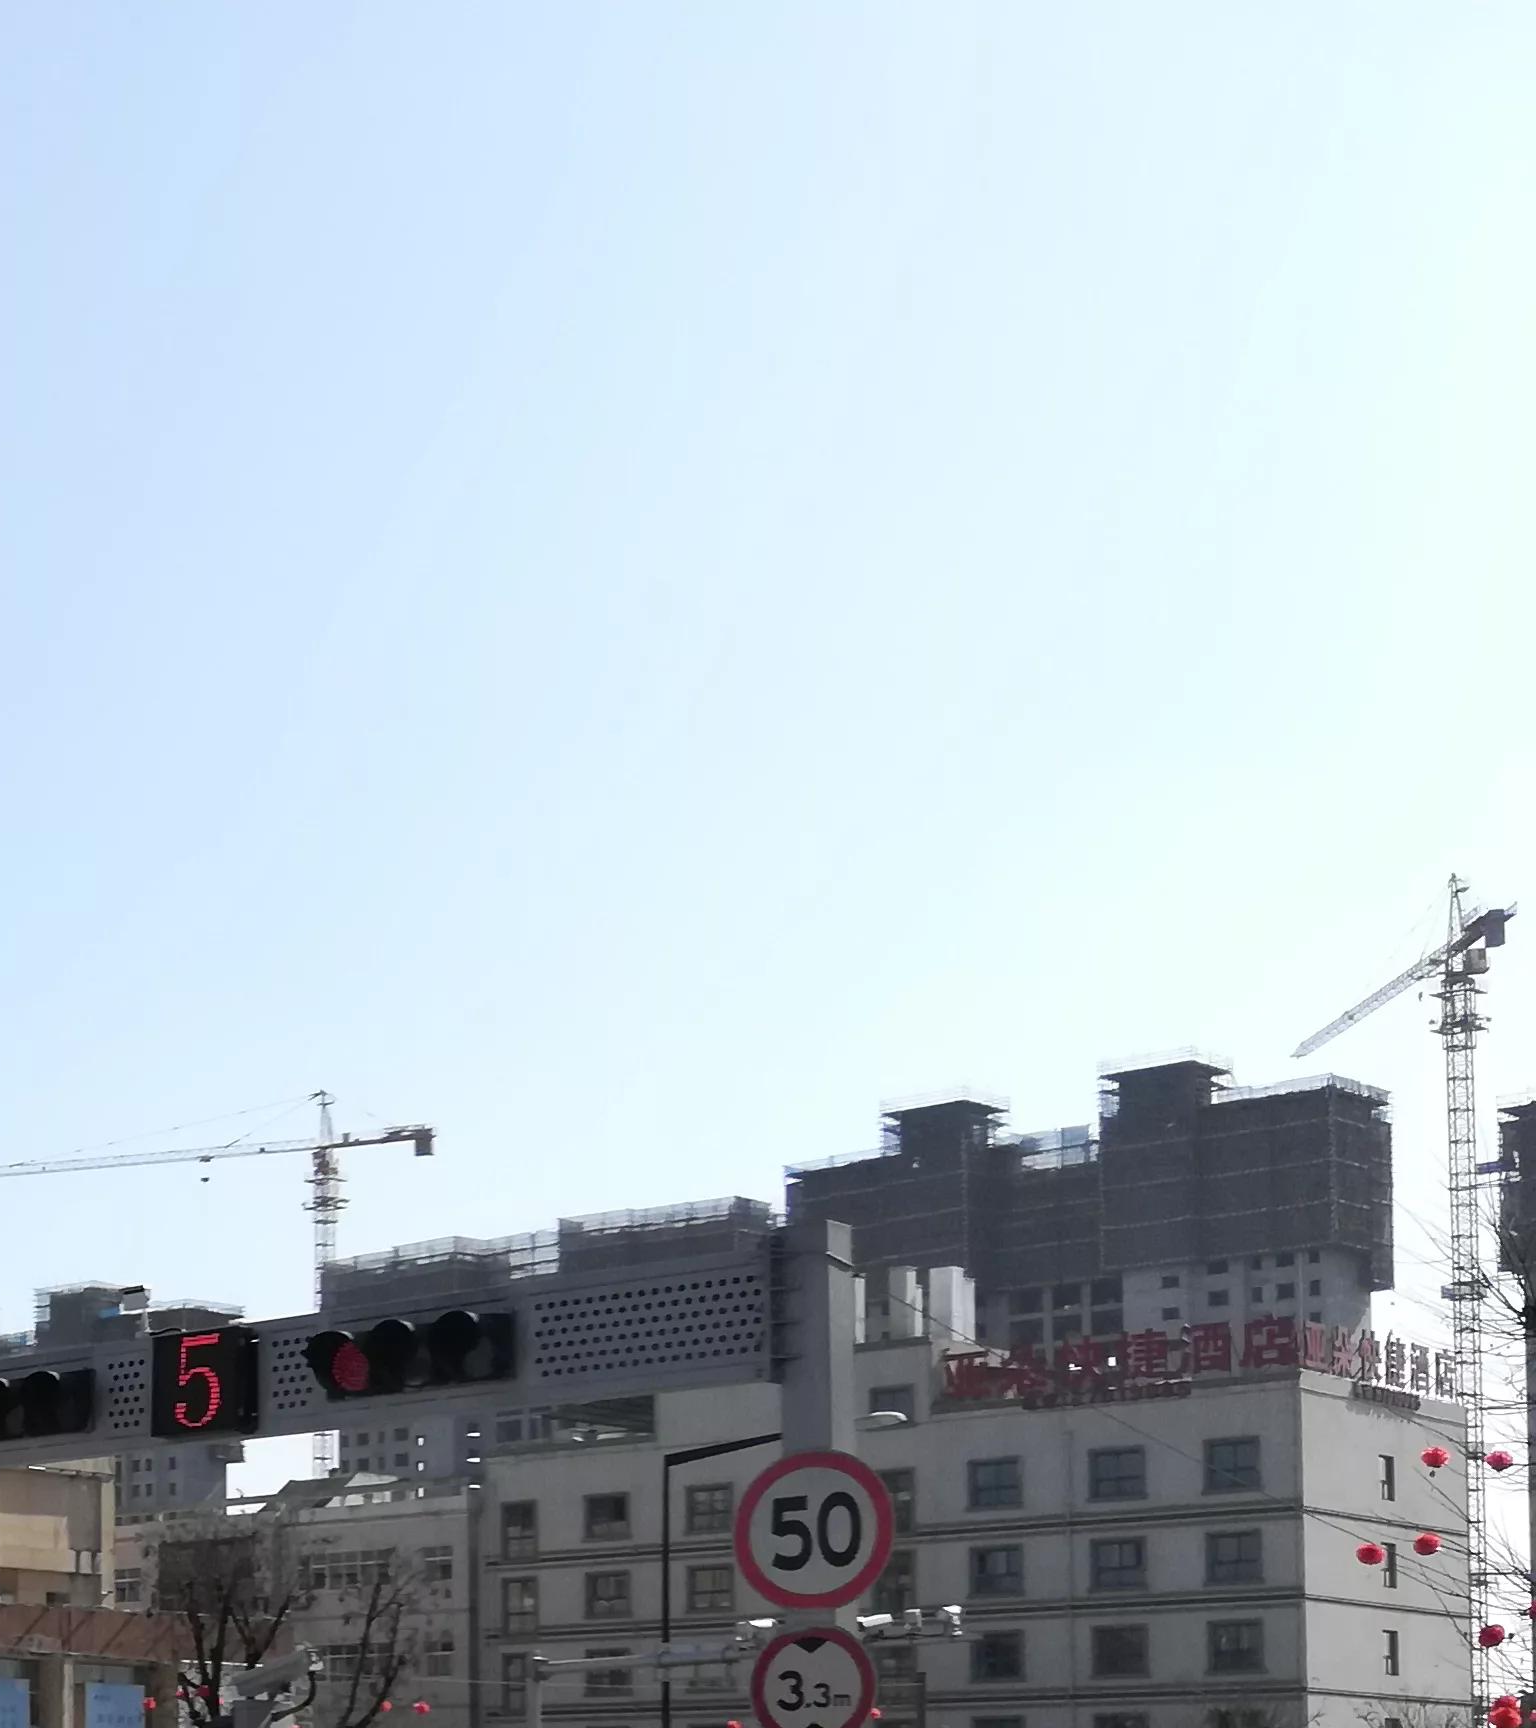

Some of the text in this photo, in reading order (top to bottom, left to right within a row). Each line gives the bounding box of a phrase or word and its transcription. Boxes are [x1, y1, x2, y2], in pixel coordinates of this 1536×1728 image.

[173, 1332, 223, 1430] 5
[771, 1492, 862, 1571] 50
[777, 1671, 853, 1712] 3.3m
